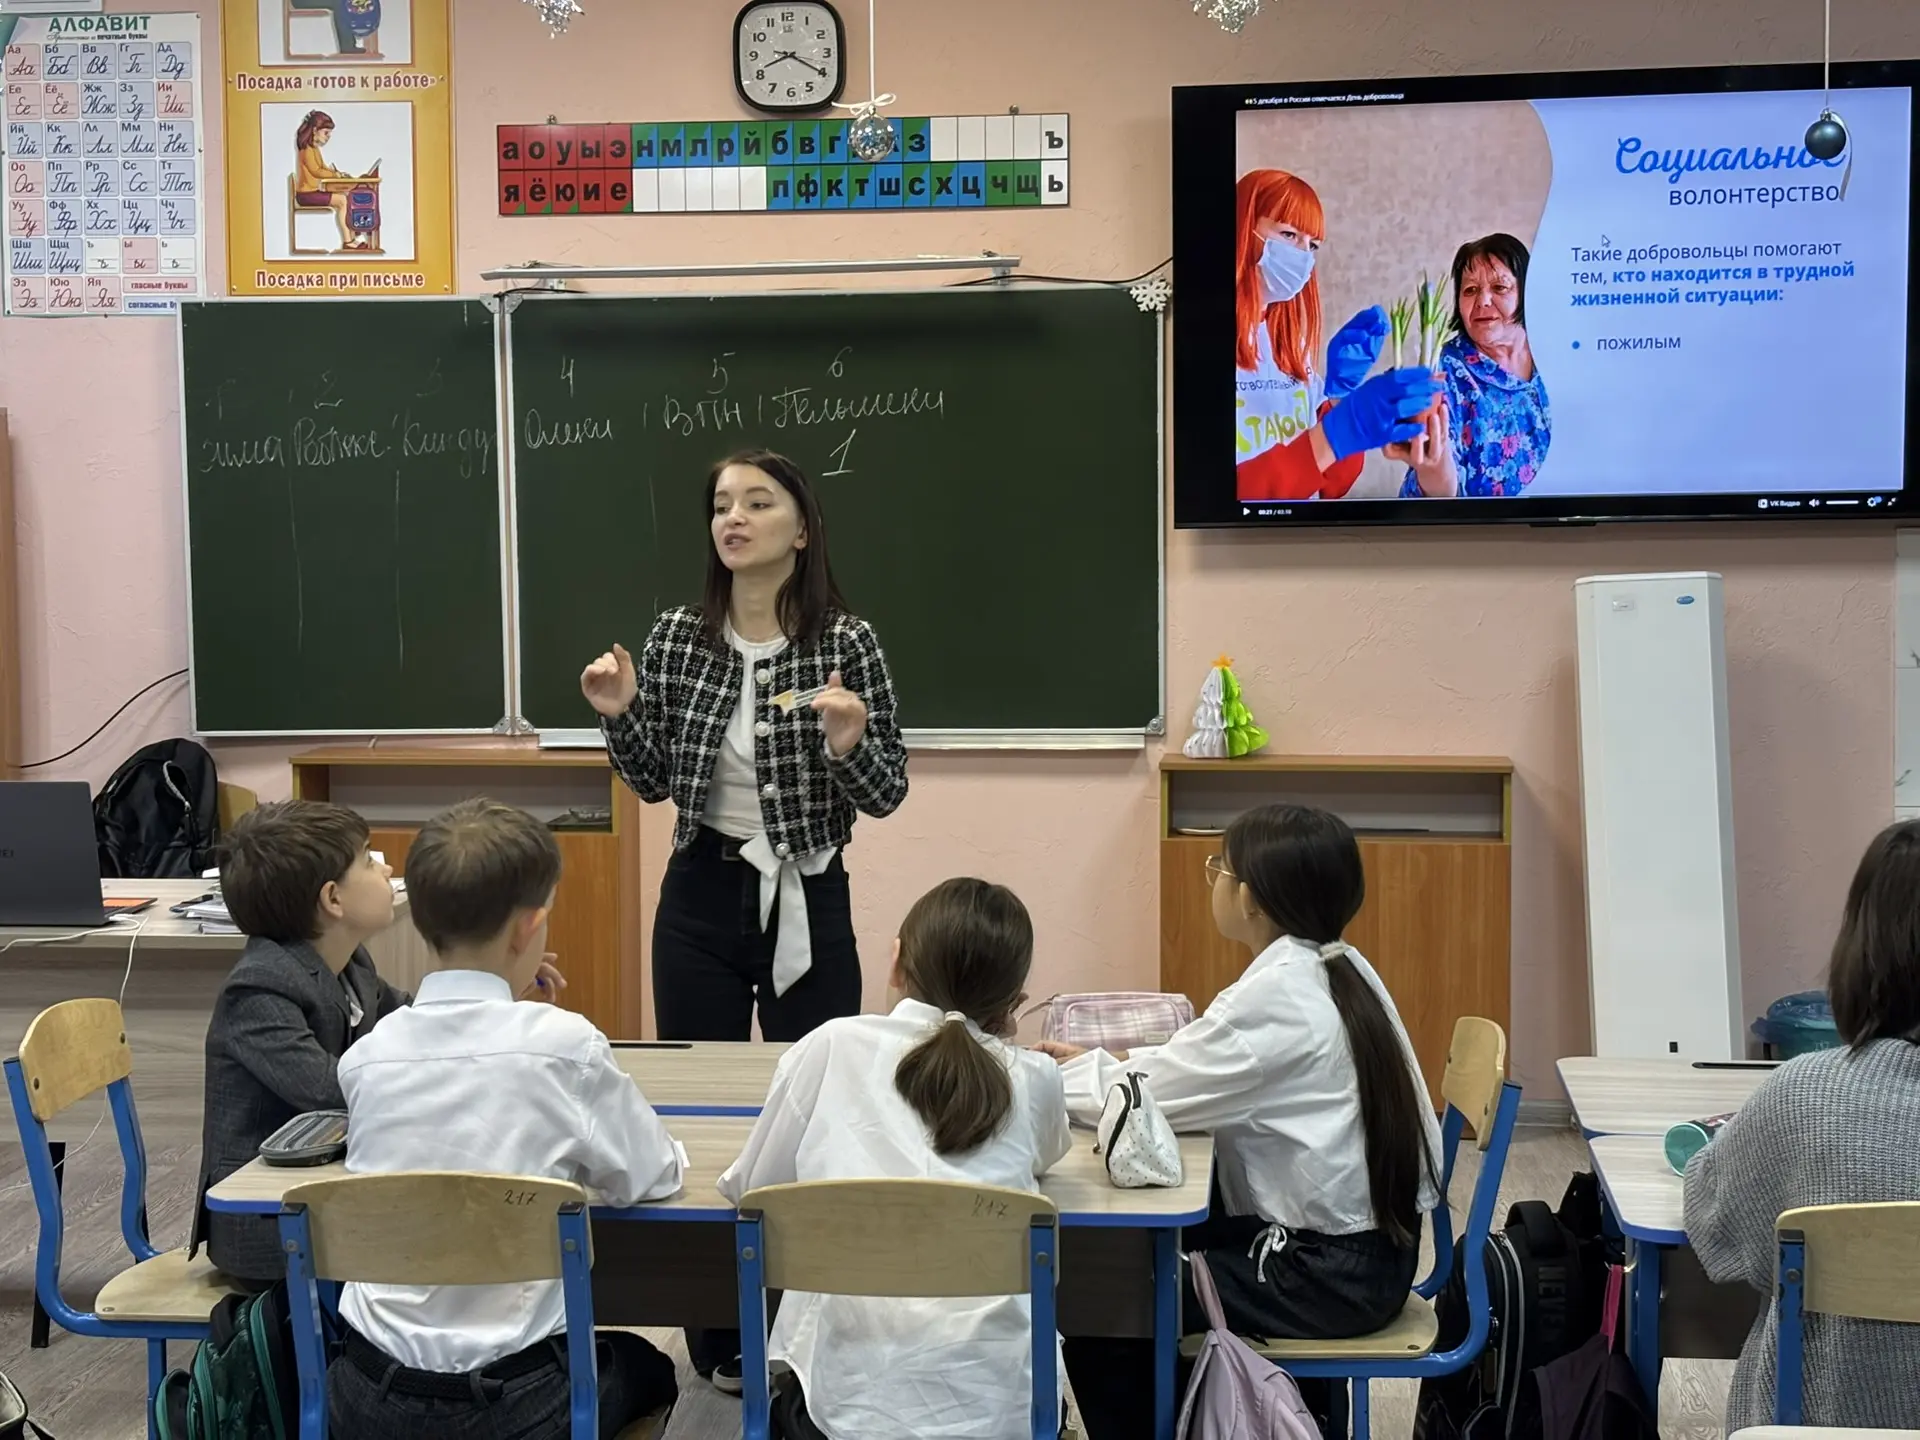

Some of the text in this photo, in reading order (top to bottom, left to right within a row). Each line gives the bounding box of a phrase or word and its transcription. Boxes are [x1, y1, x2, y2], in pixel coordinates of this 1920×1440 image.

[49, 16, 151, 32] АЛФАВИТ
[767, 18, 774, 27] 11
[781, 12, 794, 21] 12
[753, 32, 766, 42] 10
[816, 30, 825, 39] 2
[749, 51, 758, 61] 9
[823, 48, 831, 58] 3
[237, 73, 302, 91] Посадка
[360, 75, 371, 88] к
[756, 70, 765, 80] 8
[768, 83, 777, 93] 7
[787, 87, 796, 97] 6
[805, 82, 813, 92] 5
[1668, 183, 1839, 207] волонтерство
[1572, 241, 1842, 264] Такие добровольцы помогают
[256, 270, 425, 289] Посадка при письме
[1571, 262, 1855, 285] тем, кто находится в трудной
[164, 282, 188, 290] буквы
[1571, 287, 1784, 306] жизненной ситуации:
[1598, 337, 1681, 351] пожилым
[826, 346, 853, 378] 6
[560, 354, 576, 399] 4
[706, 351, 736, 394] 5
[821, 428, 857, 477] 1
[503, 1189, 538, 1206] 217
